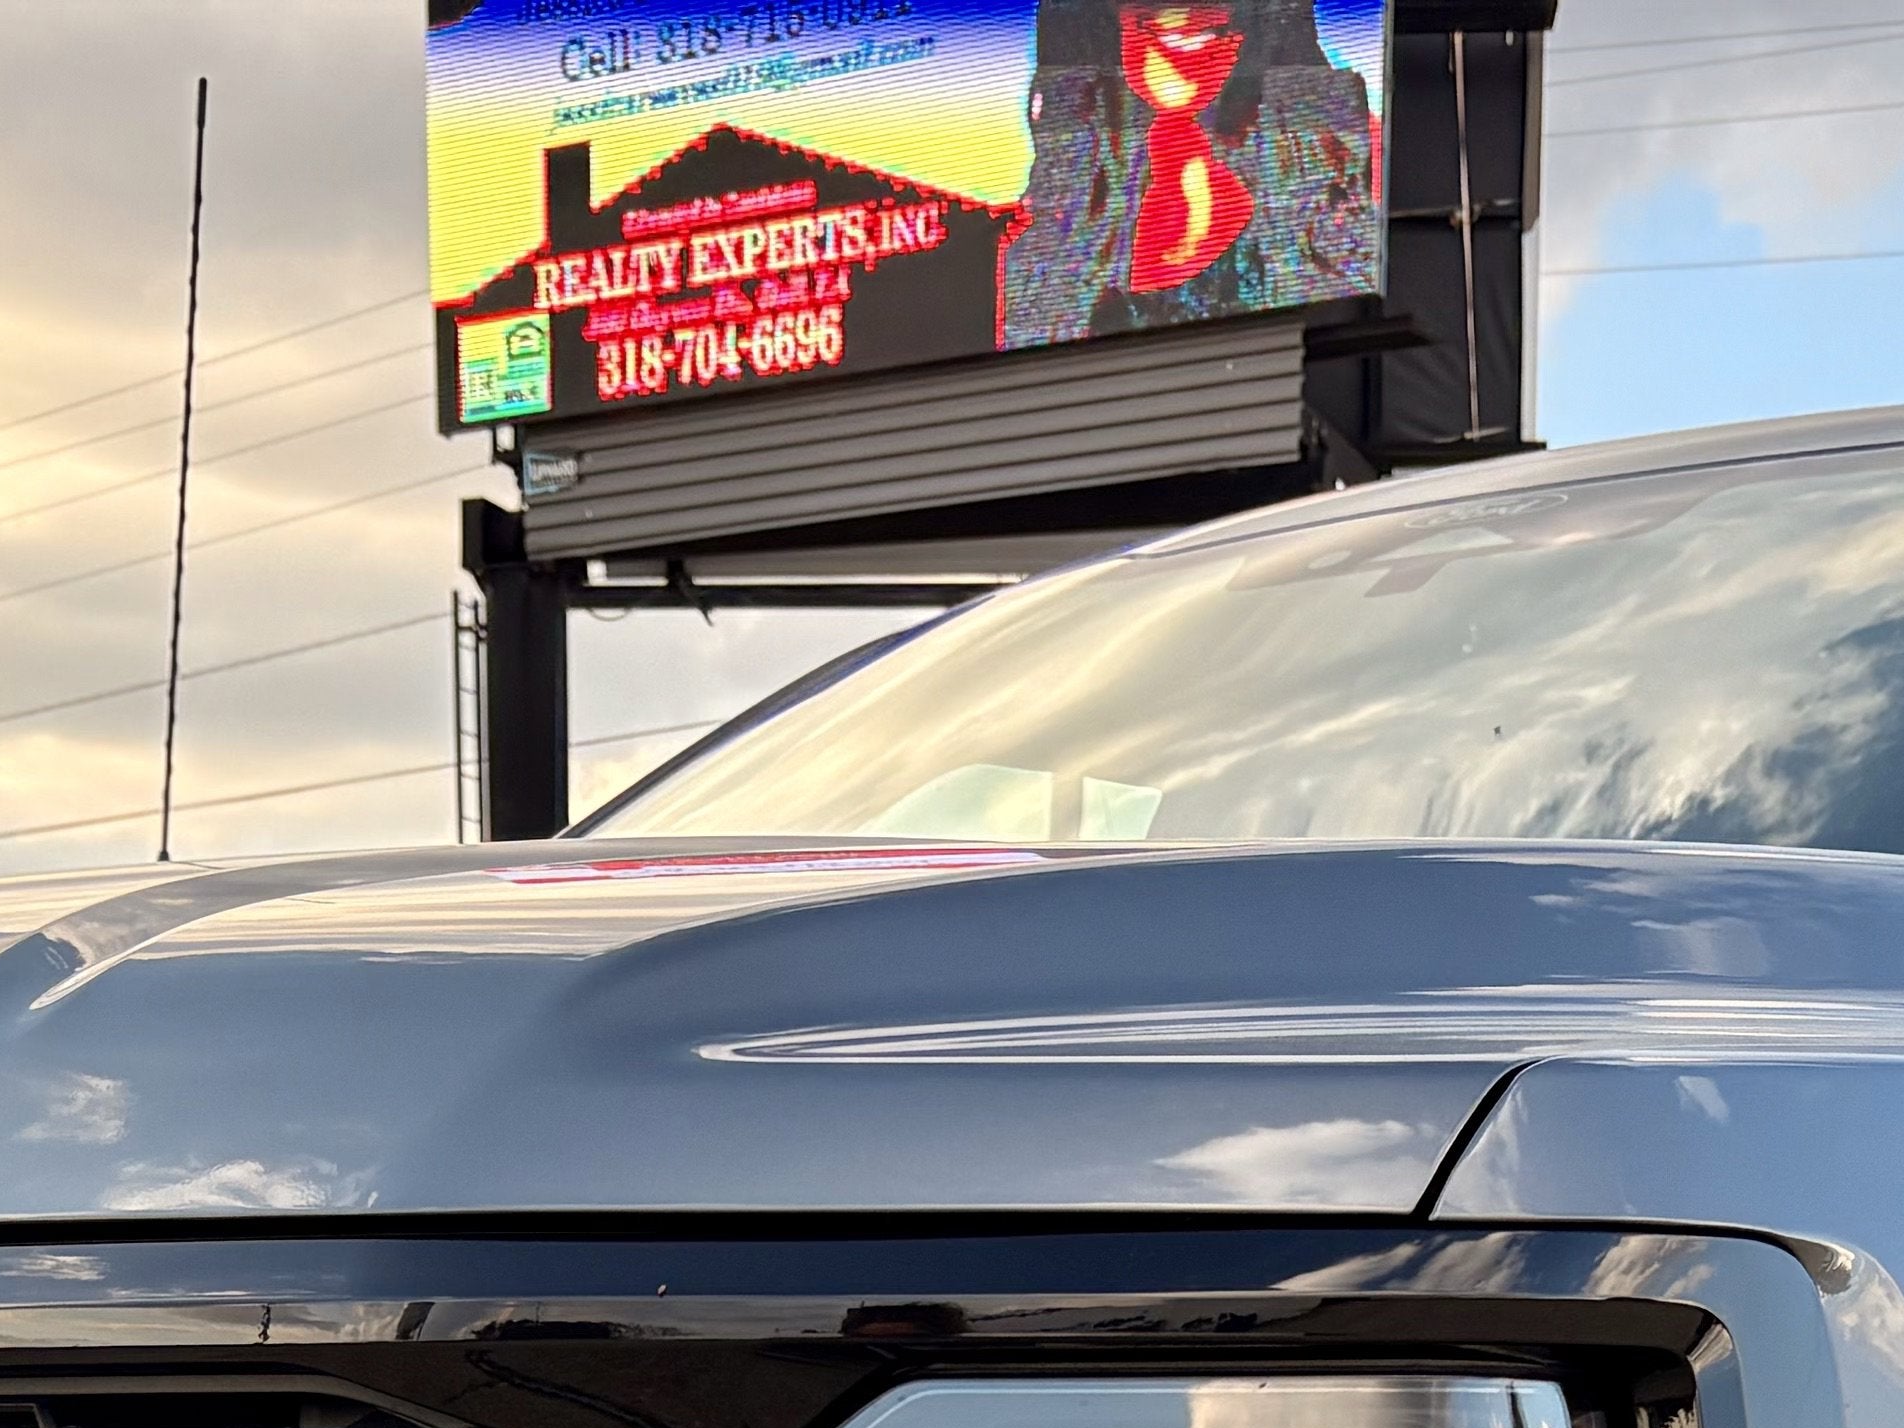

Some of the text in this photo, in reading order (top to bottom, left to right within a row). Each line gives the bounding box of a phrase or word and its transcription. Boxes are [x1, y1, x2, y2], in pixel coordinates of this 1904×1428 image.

[561, 28, 641, 81] Cell:
[533, 238, 683, 310] REALTY
[598, 303, 844, 397] 318-704-6696
